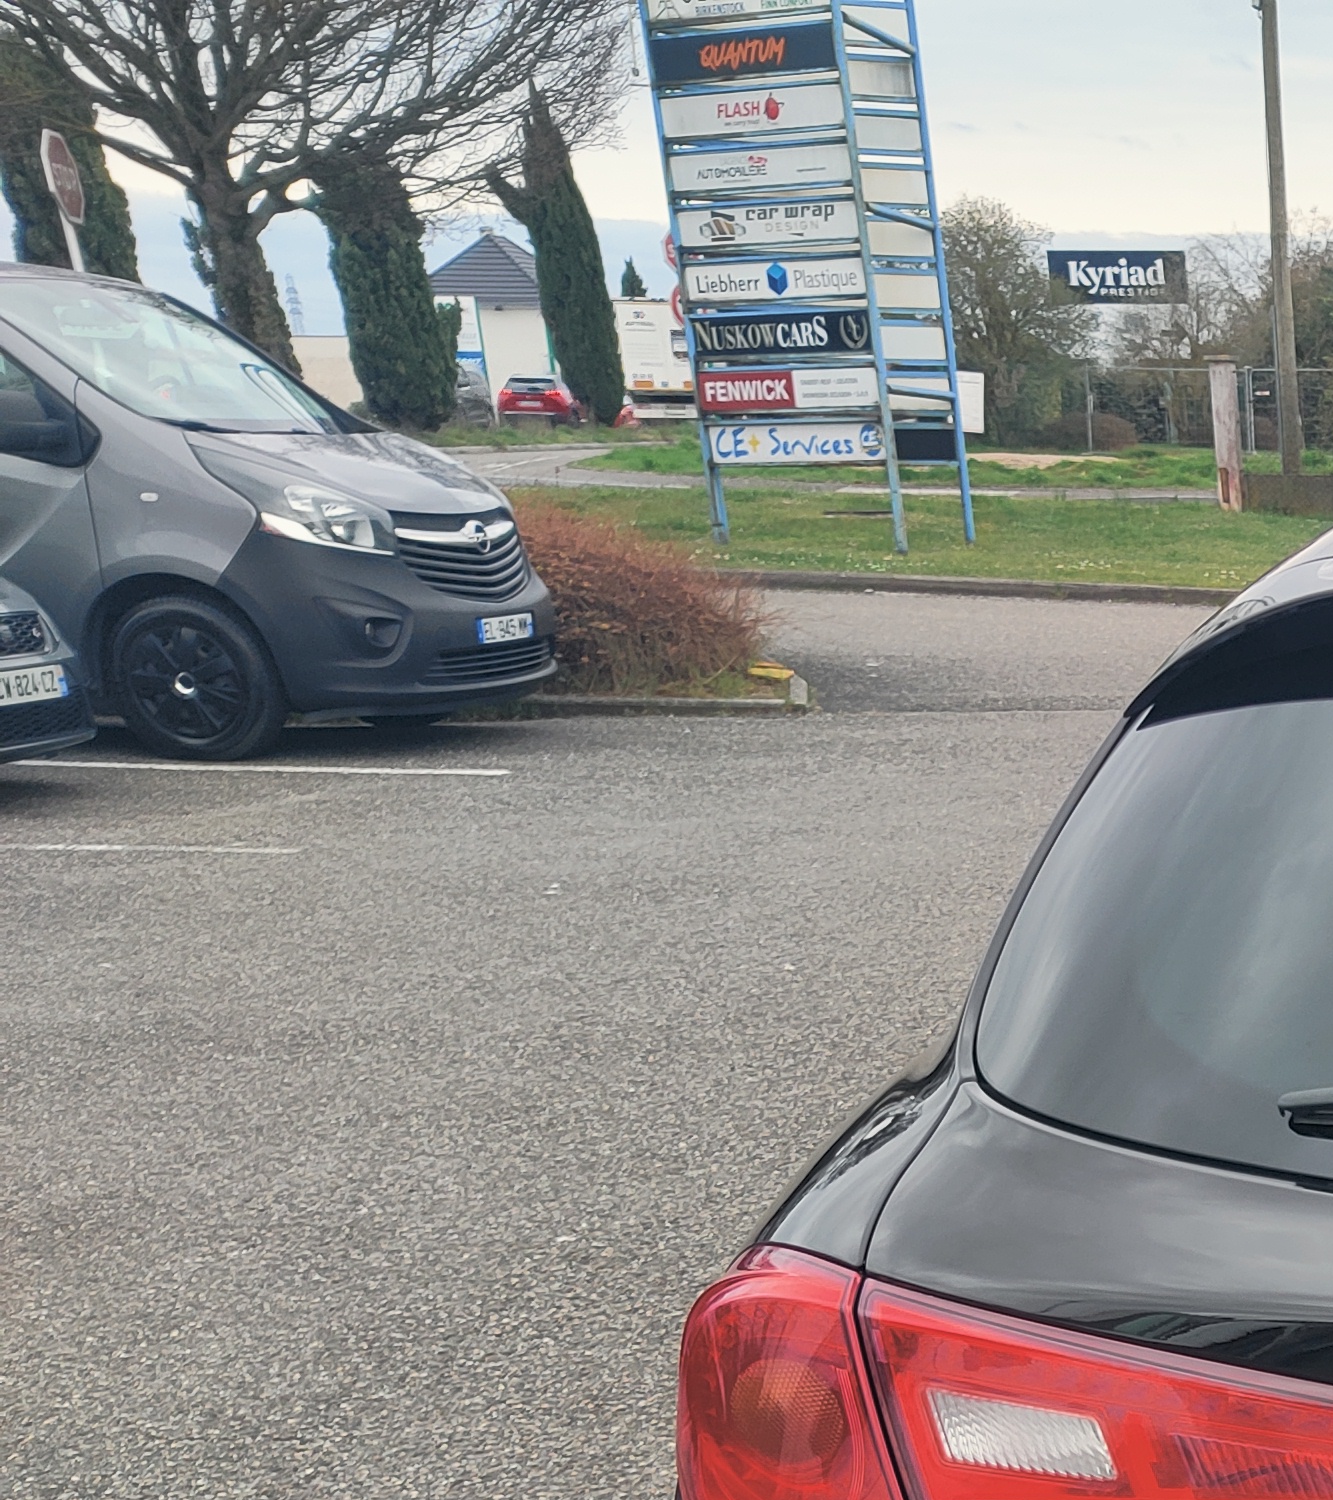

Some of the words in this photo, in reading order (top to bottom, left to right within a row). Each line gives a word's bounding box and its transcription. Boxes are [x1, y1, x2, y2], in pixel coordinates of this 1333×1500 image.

[700, 36, 786, 70] QUANTUM
[717, 101, 760, 119] FLASH
[745, 206, 779, 221] car
[784, 204, 835, 222] wrap
[764, 220, 820, 233] DESIGN
[696, 274, 760, 294] Liebherr
[793, 269, 858, 292] Plastique
[1067, 257, 1166, 295] Kyriad
[704, 379, 790, 402] FENWICK
[716, 427, 749, 459] CE
[768, 427, 853, 456] Services
